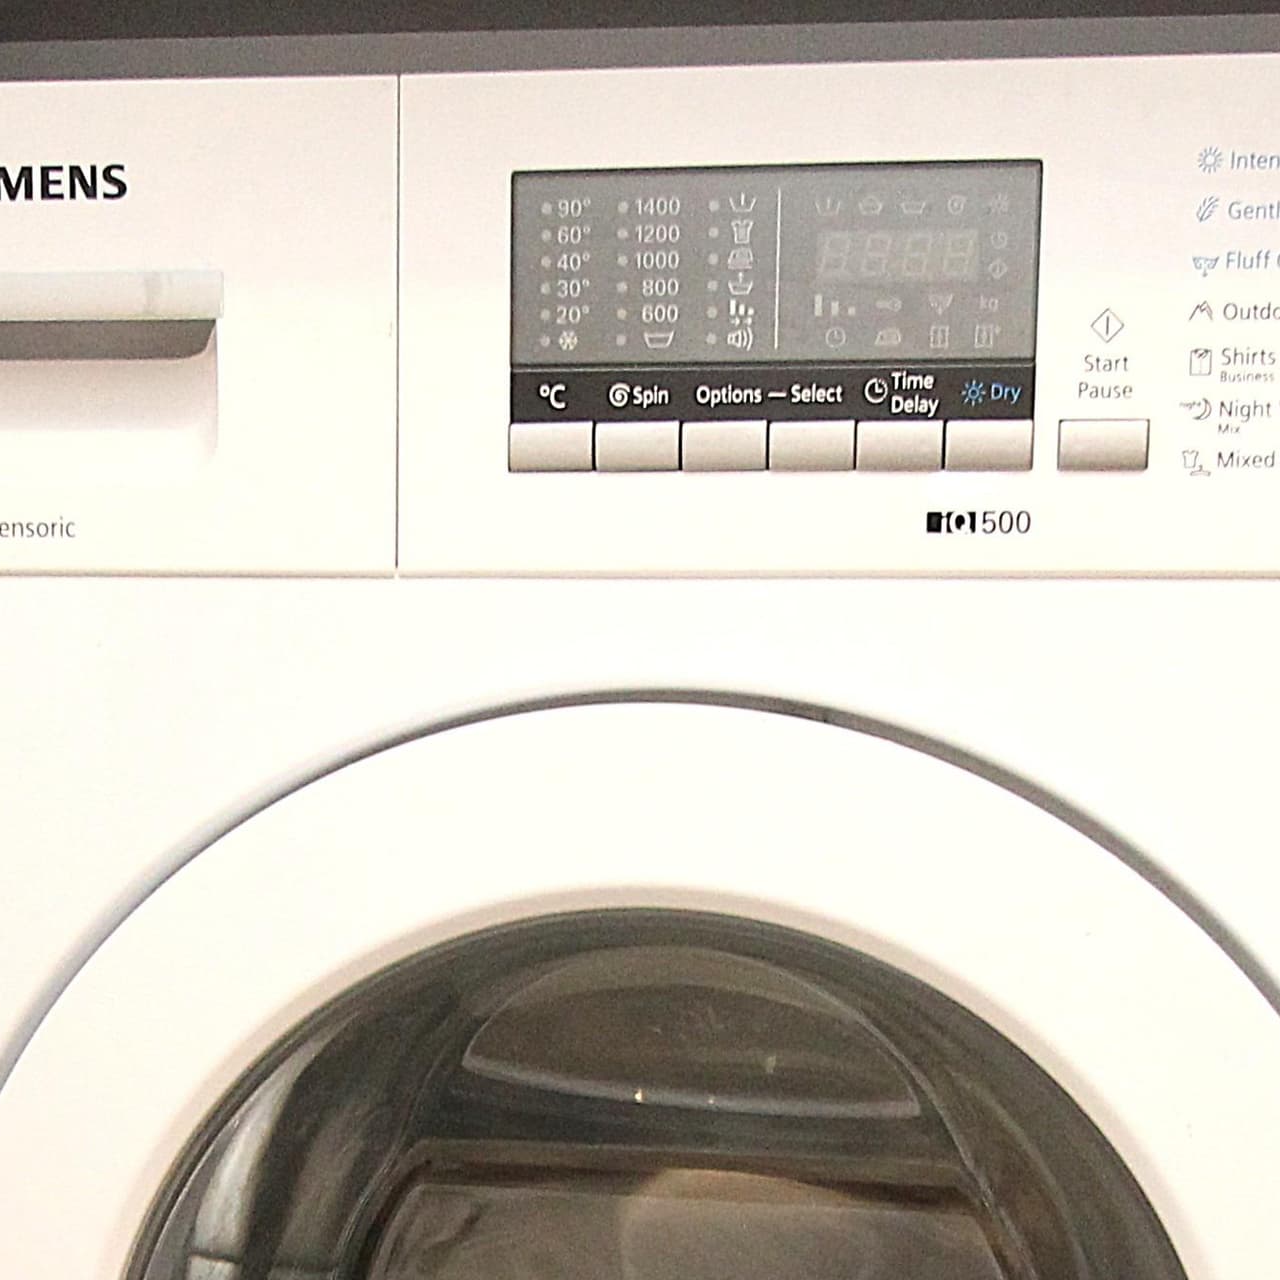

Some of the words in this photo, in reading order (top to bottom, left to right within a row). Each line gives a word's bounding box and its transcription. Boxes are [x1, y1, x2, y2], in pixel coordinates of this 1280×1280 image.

[557, 197, 591, 218] 90°
[635, 197, 680, 216] 1400
[557, 225, 591, 244] 60°
[635, 224, 680, 243] 1200
[557, 252, 590, 271] 40°
[635, 251, 680, 269] 1000
[1225, 251, 1270, 269] Fluff
[557, 279, 590, 297] 30°
[642, 278, 679, 296] 800
[556, 305, 590, 324] 20°
[641, 305, 679, 323] 600
[1083, 354, 1129, 372] Start
[1221, 348, 1276, 366] Shirts
[891, 371, 935, 391] Time
[1078, 382, 1133, 399] Pause
[632, 385, 669, 408] Spin
[696, 384, 762, 408] Options
[791, 384, 843, 404] Select
[990, 383, 1021, 404] Dry
[891, 395, 939, 417] Delay
[1219, 399, 1271, 421] Night
[1217, 451, 1275, 469] Mixed
